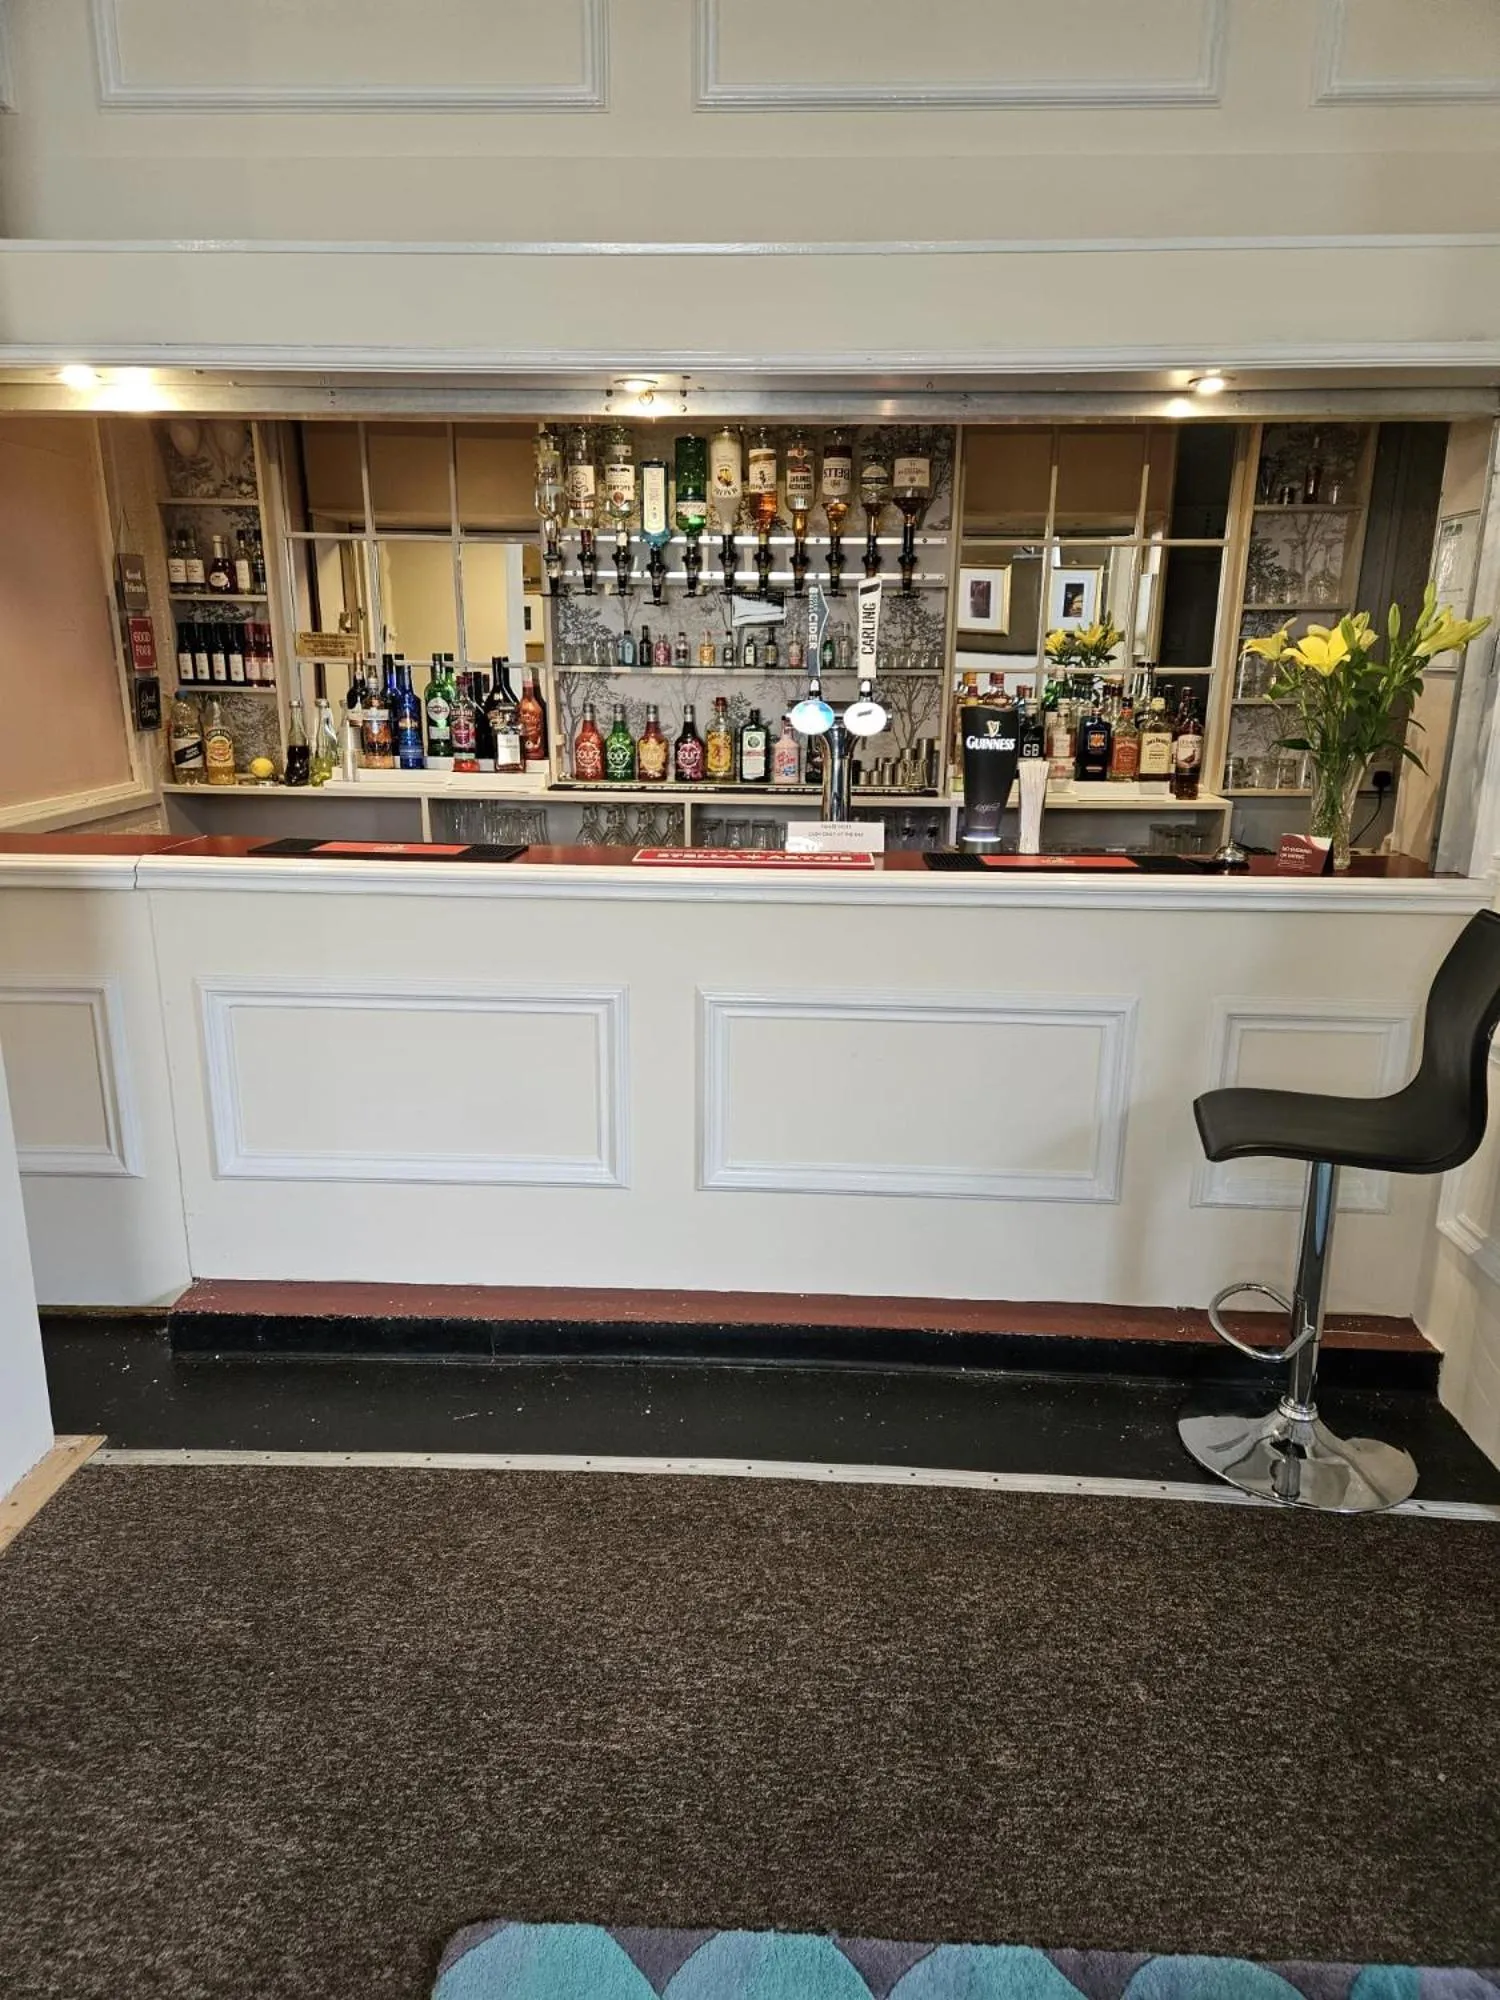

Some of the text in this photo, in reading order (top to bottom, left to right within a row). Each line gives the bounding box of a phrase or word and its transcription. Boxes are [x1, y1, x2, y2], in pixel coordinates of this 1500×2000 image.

[808, 614, 819, 650] CIDER
[862, 602, 877, 655] CARLING
[966, 735, 1016, 750] GUINNESS
[1023, 743, 1040, 757] GB
[656, 852, 854, 861] STELLA ARTOIS
